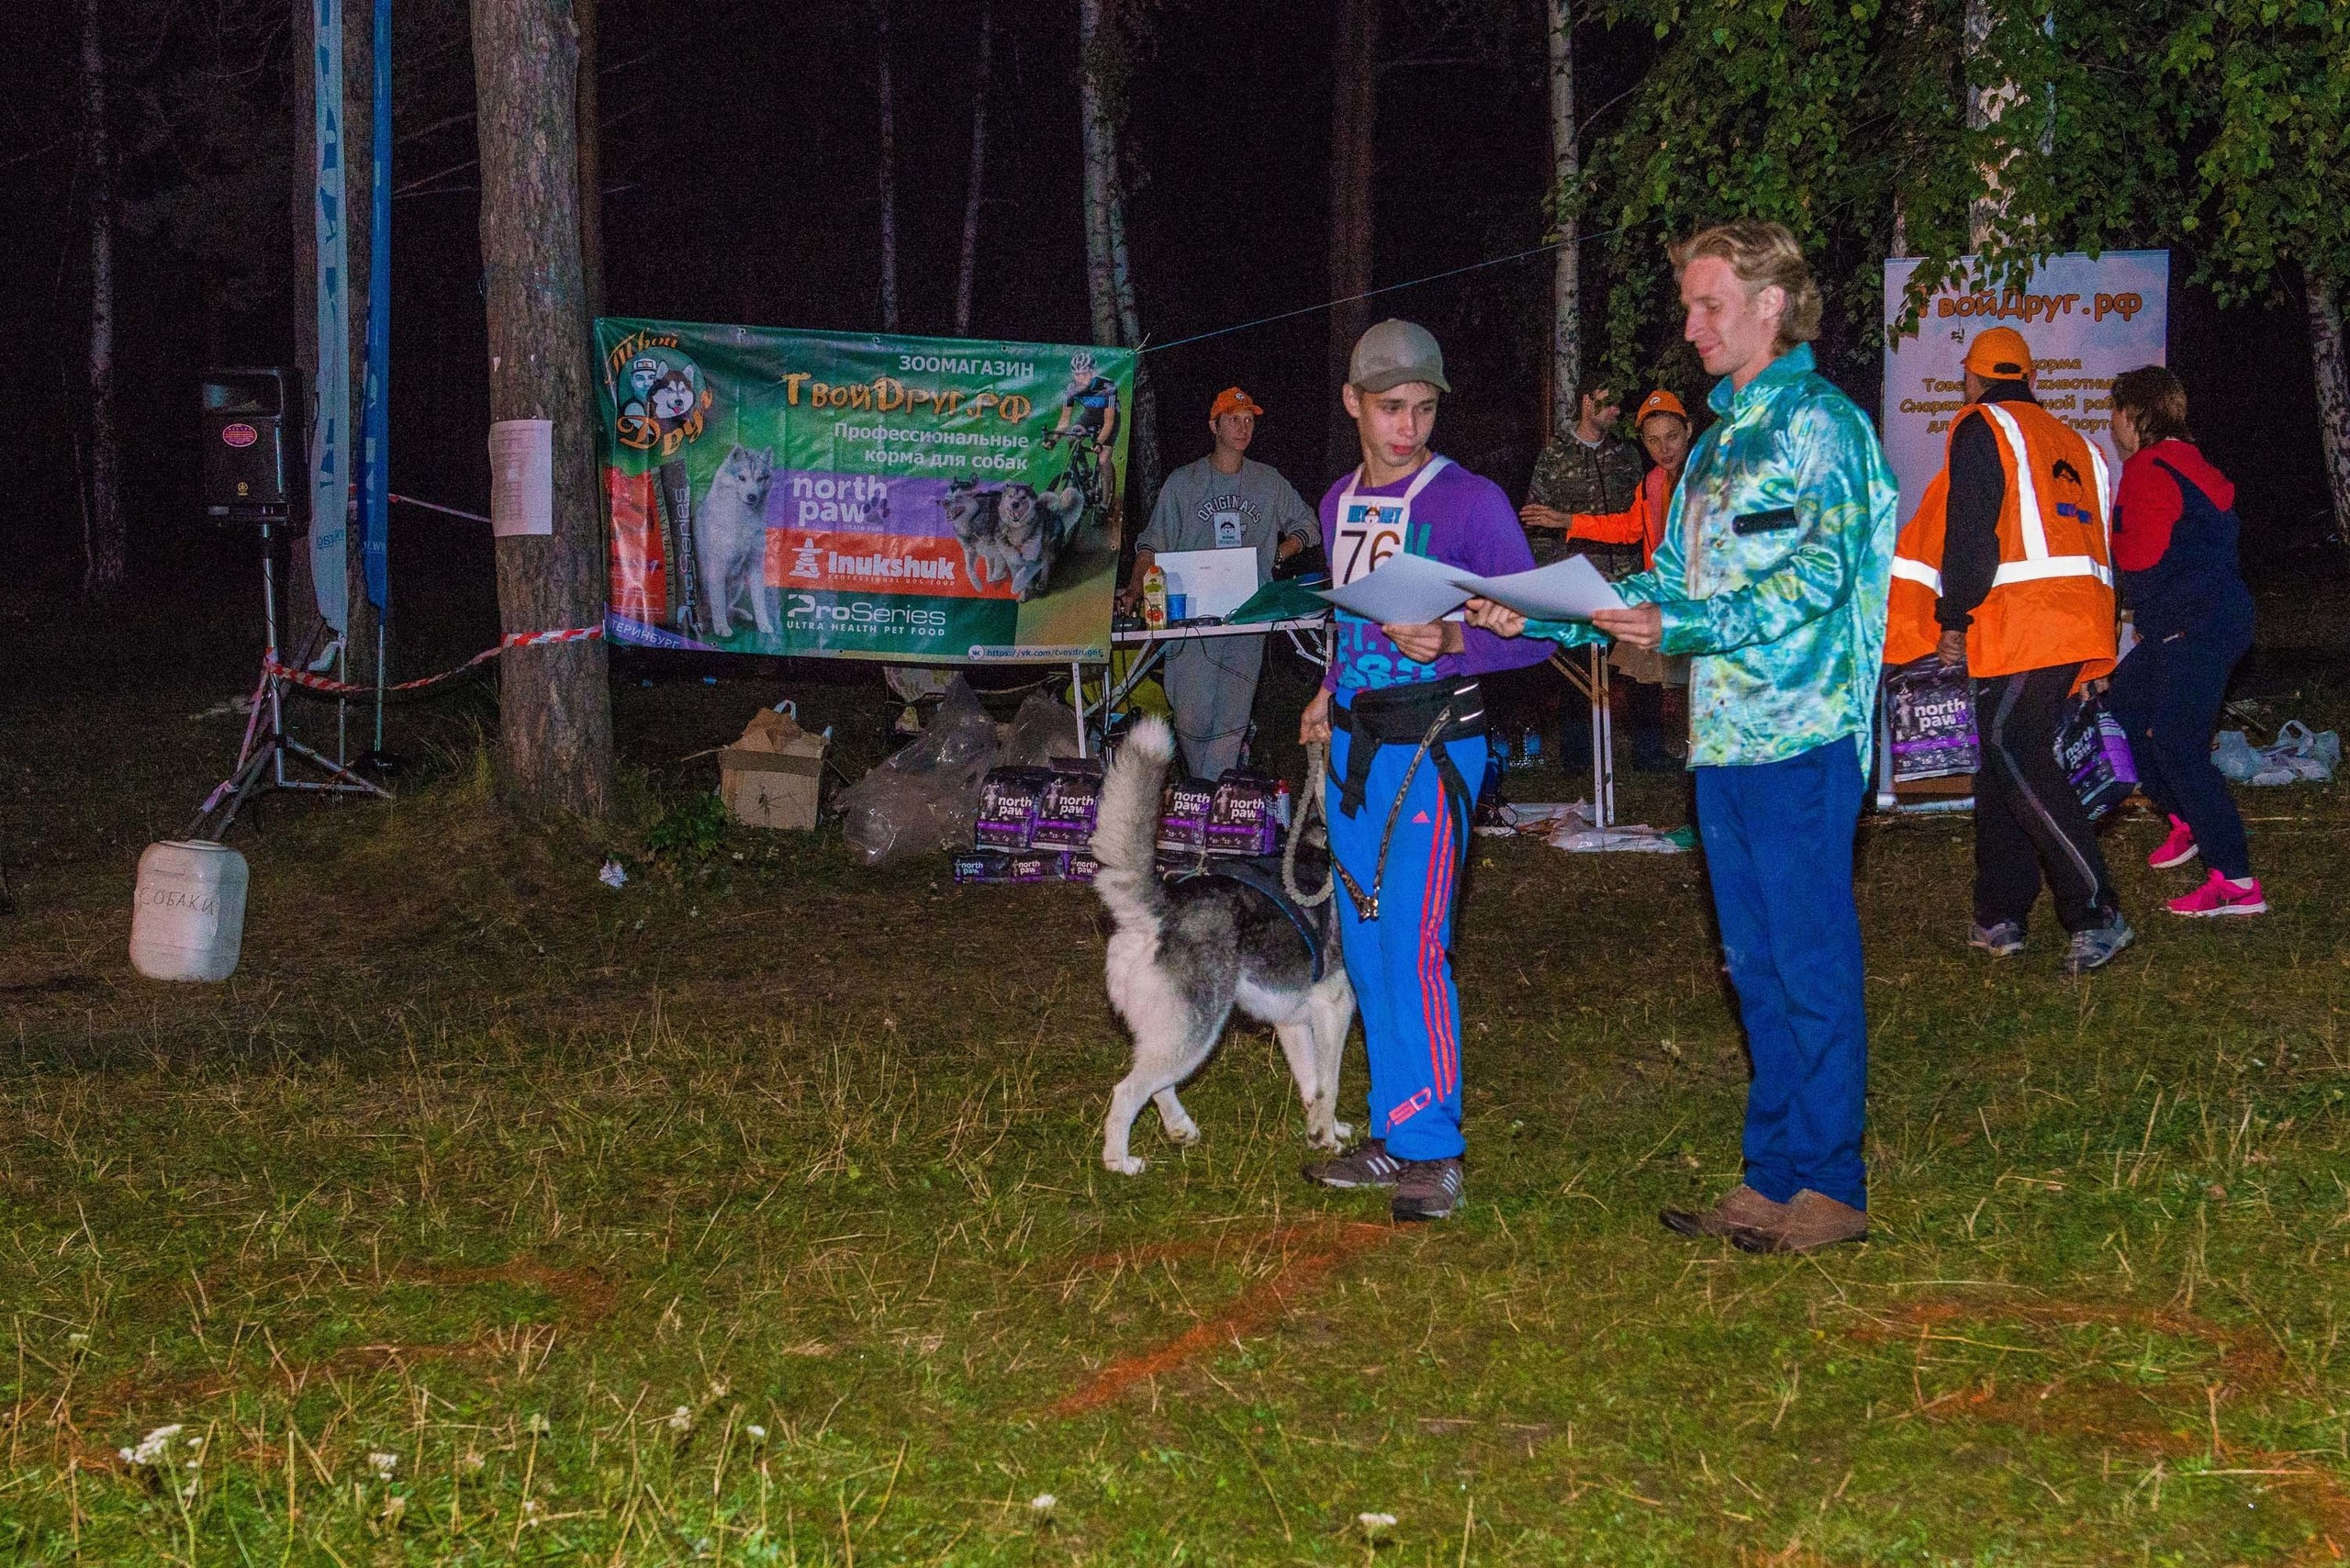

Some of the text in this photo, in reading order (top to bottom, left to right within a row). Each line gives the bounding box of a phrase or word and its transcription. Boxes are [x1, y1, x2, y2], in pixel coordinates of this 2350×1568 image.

[898, 355, 1035, 378] ЗООМАГАЗИН
[1921, 377, 2114, 392] Това животны
[1899, 398, 1966, 415] Снаряж
[2056, 415, 2112, 431] Спорт
[834, 422, 1029, 448] Профессиональные
[865, 447, 1028, 471] корма для собак
[792, 475, 888, 501] north
[798, 499, 866, 527] paw
[1197, 495, 1261, 523] ORIGINALS
[828, 551, 956, 580] Inukshuk
[1341, 530, 1401, 585] 76
[828, 574, 900, 584] PROFESSIONAL
[787, 594, 946, 626] ProSeries
[610, 620, 680, 649] ТЕРИНБУРГ
[787, 621, 946, 636] ULTRA HEALTH PET FOOD
[1914, 698, 1965, 717] north
[1919, 713, 1956, 732] paw
[2065, 726, 2096, 759] north
[998, 796, 1032, 807] north
[1059, 795, 1094, 806] north
[1174, 791, 1210, 804] north
[1174, 801, 1201, 812] paw
[1230, 799, 1265, 810] north
[998, 806, 1024, 816] paw
[1059, 805, 1085, 814] paw
[1231, 808, 1257, 820] paw
[139, 887, 217, 915] СОБАКИ
